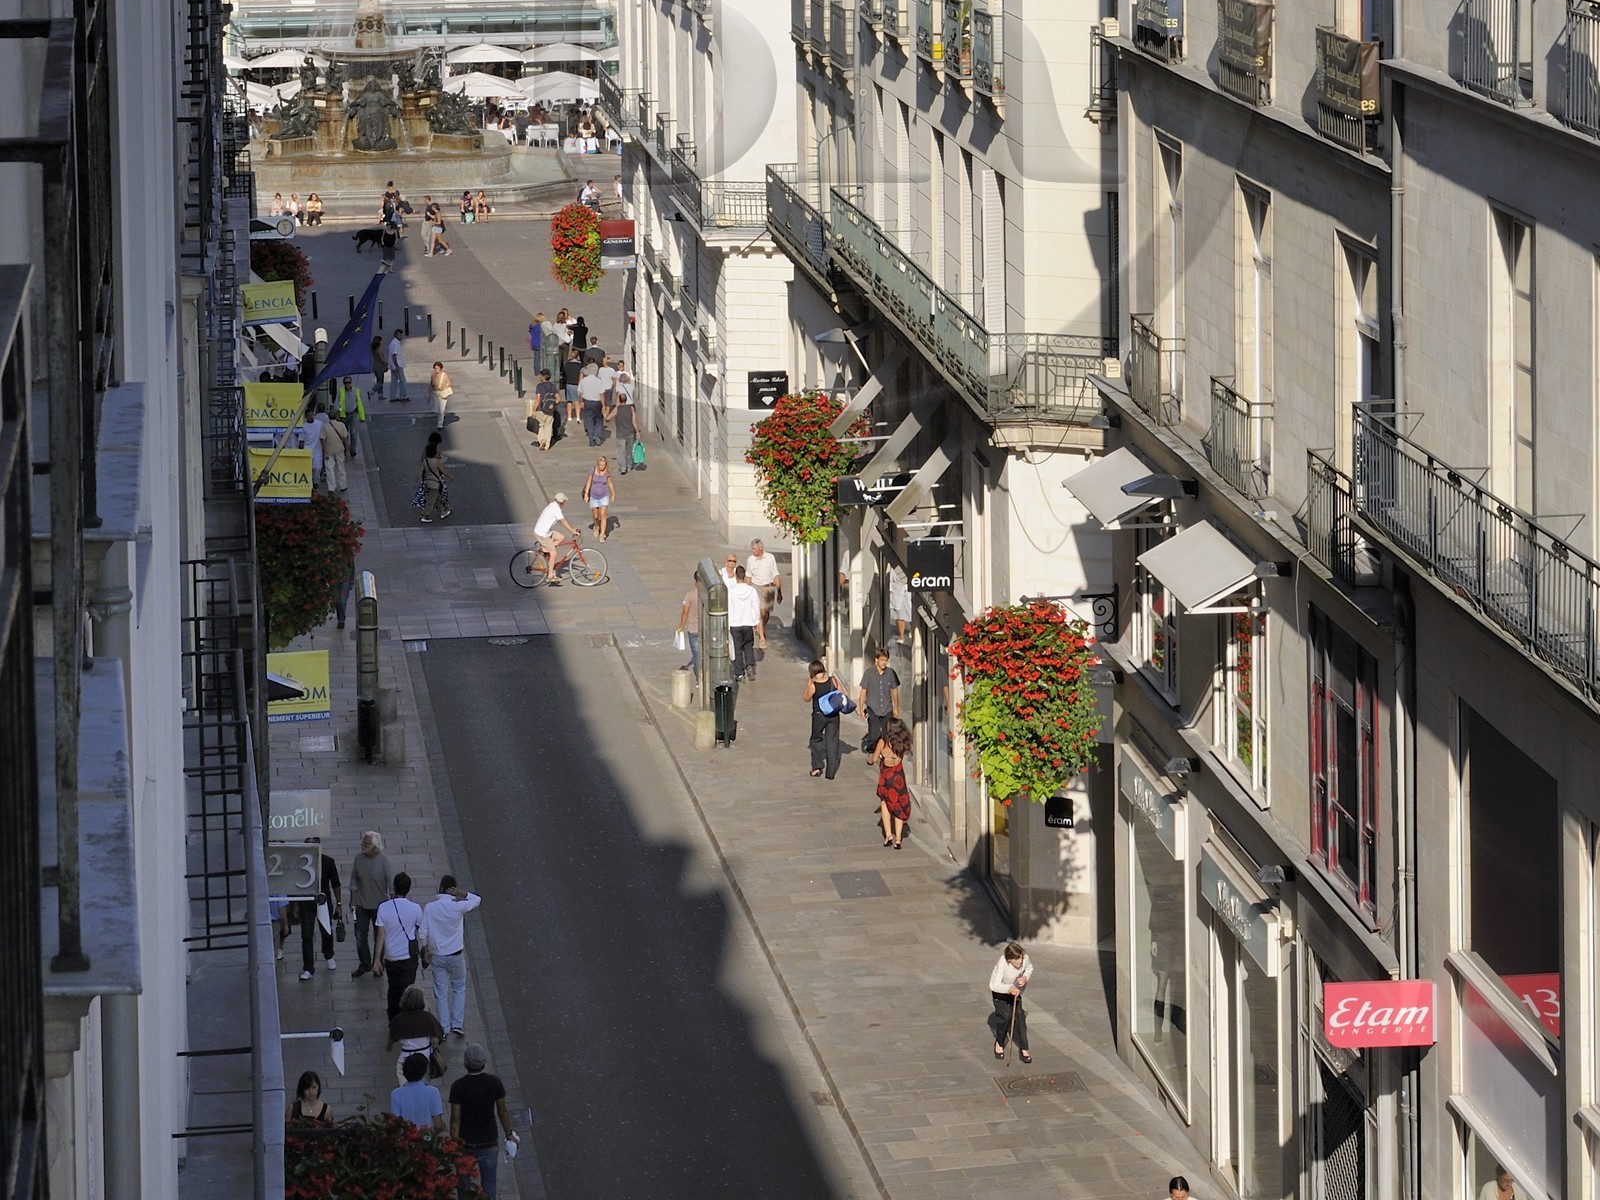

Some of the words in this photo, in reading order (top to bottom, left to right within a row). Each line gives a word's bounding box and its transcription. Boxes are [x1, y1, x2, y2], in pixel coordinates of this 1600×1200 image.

[911, 572, 951, 588] éram
[294, 711, 331, 721] SUPERIEUR
[1047, 814, 1073, 827] éram
[1329, 997, 1430, 1028] Etam
[1329, 1025, 1428, 1036] LINGERIE
